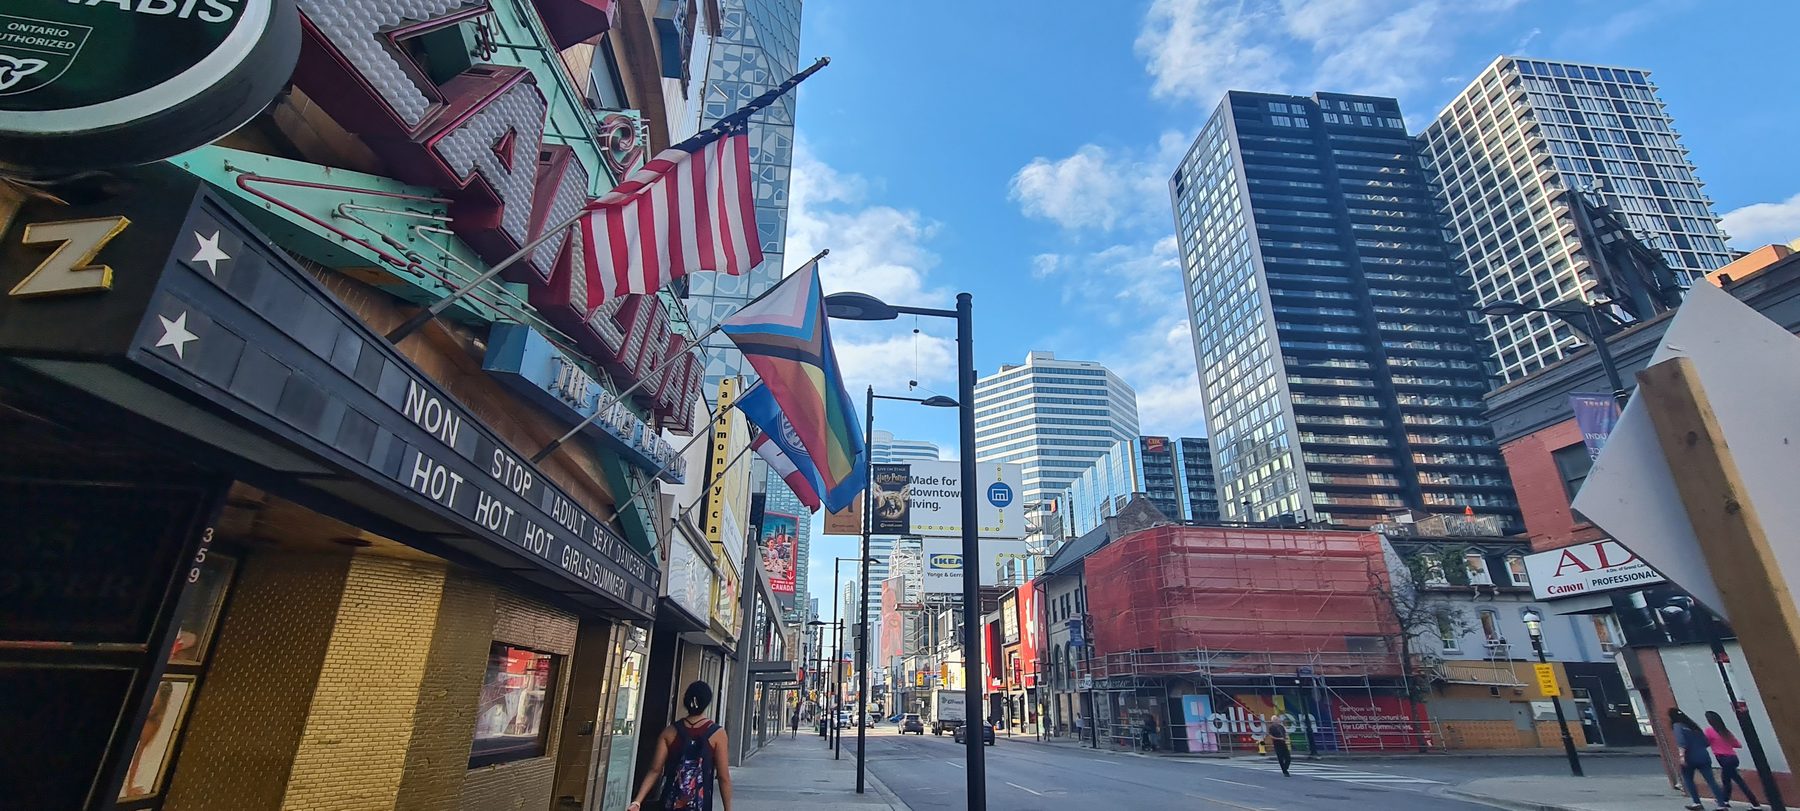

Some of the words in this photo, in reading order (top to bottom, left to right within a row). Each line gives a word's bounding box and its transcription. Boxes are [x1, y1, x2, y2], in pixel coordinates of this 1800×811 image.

[7, 22, 70, 37] ONTARIO
[0, 32, 76, 50] UTHORIZED
[8, 215, 132, 296] Z
[403, 379, 461, 448] NON
[491, 448, 532, 497] STOP
[551, 496, 587, 539] ADULT
[592, 526, 614, 557] SEXY
[876, 473, 891, 484] Harry
[891, 472, 907, 482] Potter
[909, 475, 939, 486] Made
[941, 475, 957, 486] for
[909, 487, 963, 498] downtow
[909, 498, 942, 511] living.
[410, 451, 464, 508] HOT
[474, 490, 514, 537] HOT
[523, 520, 554, 559] HOT
[561, 544, 592, 580] GIRLS
[187, 527, 214, 583] 359
[771, 583, 794, 592] CANADA
[1547, 581, 1584, 595] Canon
[1592, 570, 1658, 587] PROFESSIONAL
[1207, 706, 1268, 740] ally
